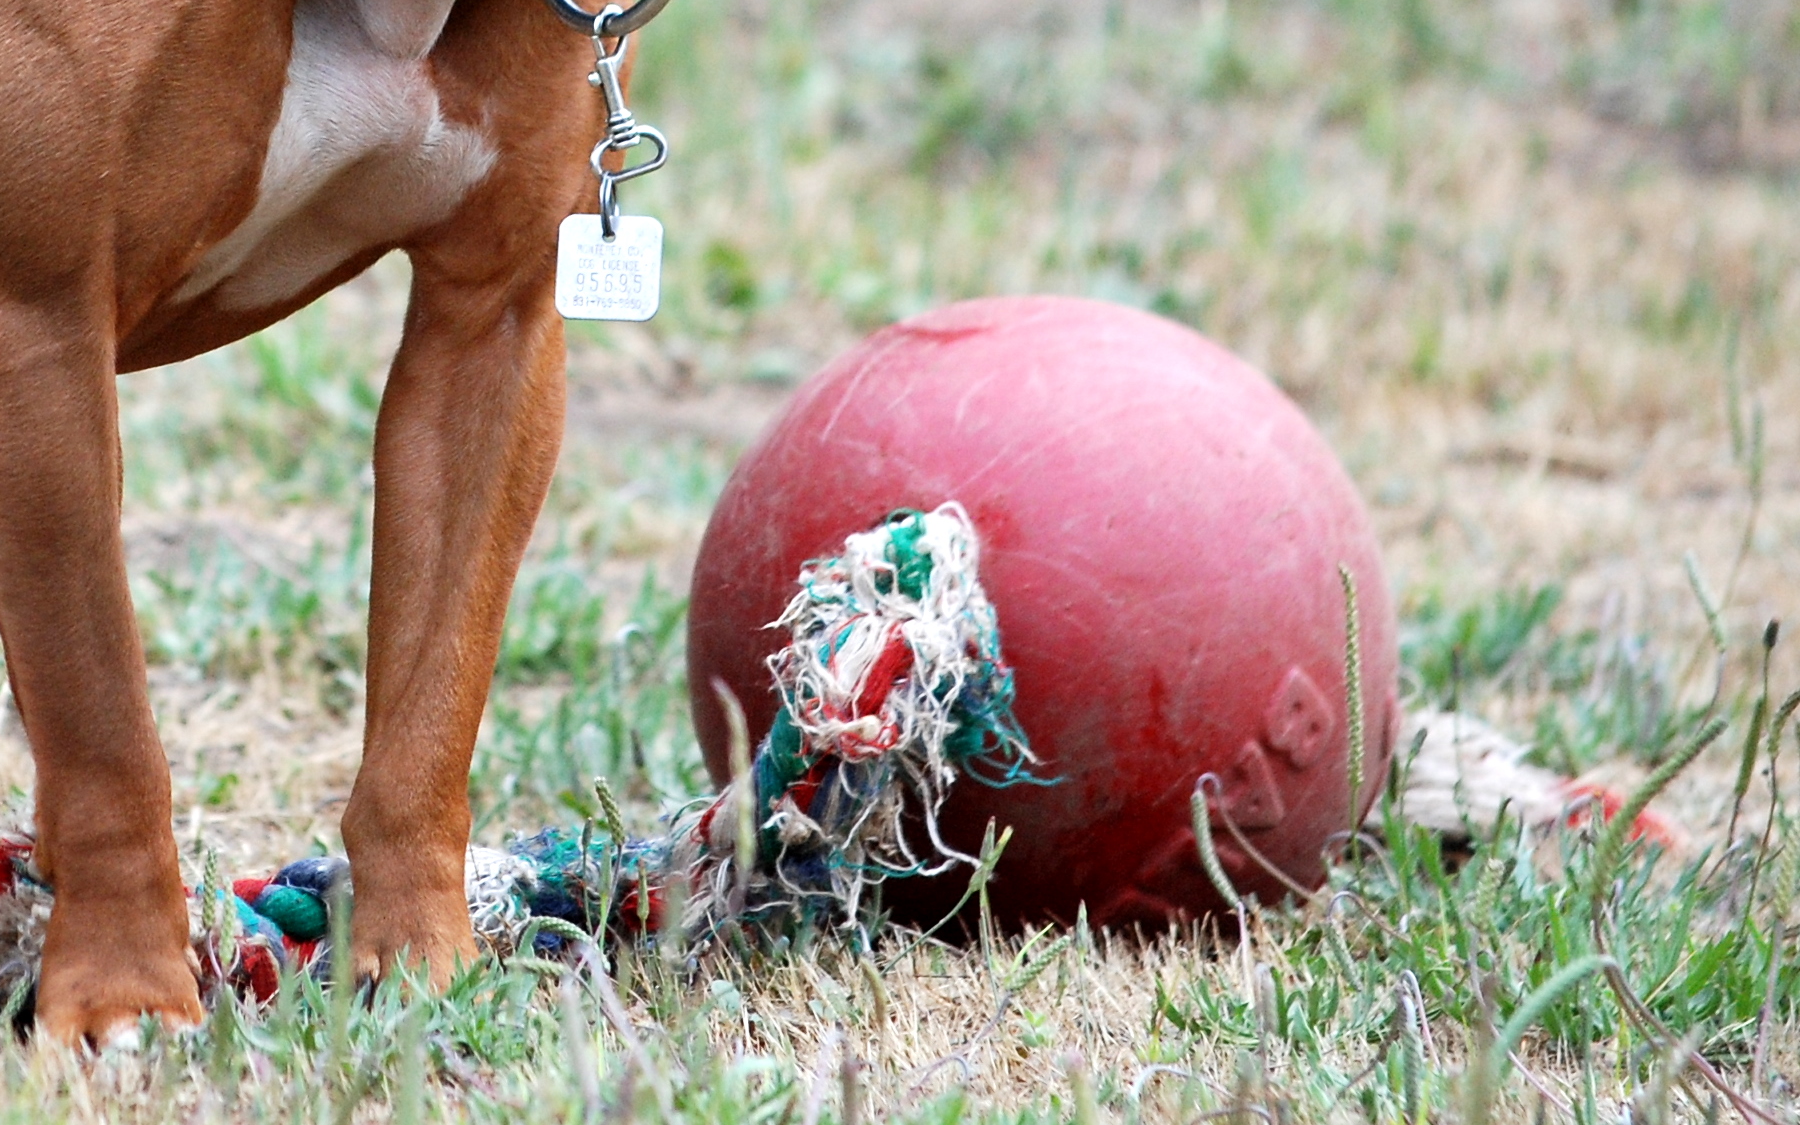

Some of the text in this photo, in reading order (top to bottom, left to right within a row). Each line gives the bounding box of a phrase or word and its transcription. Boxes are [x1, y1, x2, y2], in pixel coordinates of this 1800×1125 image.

[579, 258, 639, 271] DOG LICENSE
[576, 272, 642, 294] 95695
